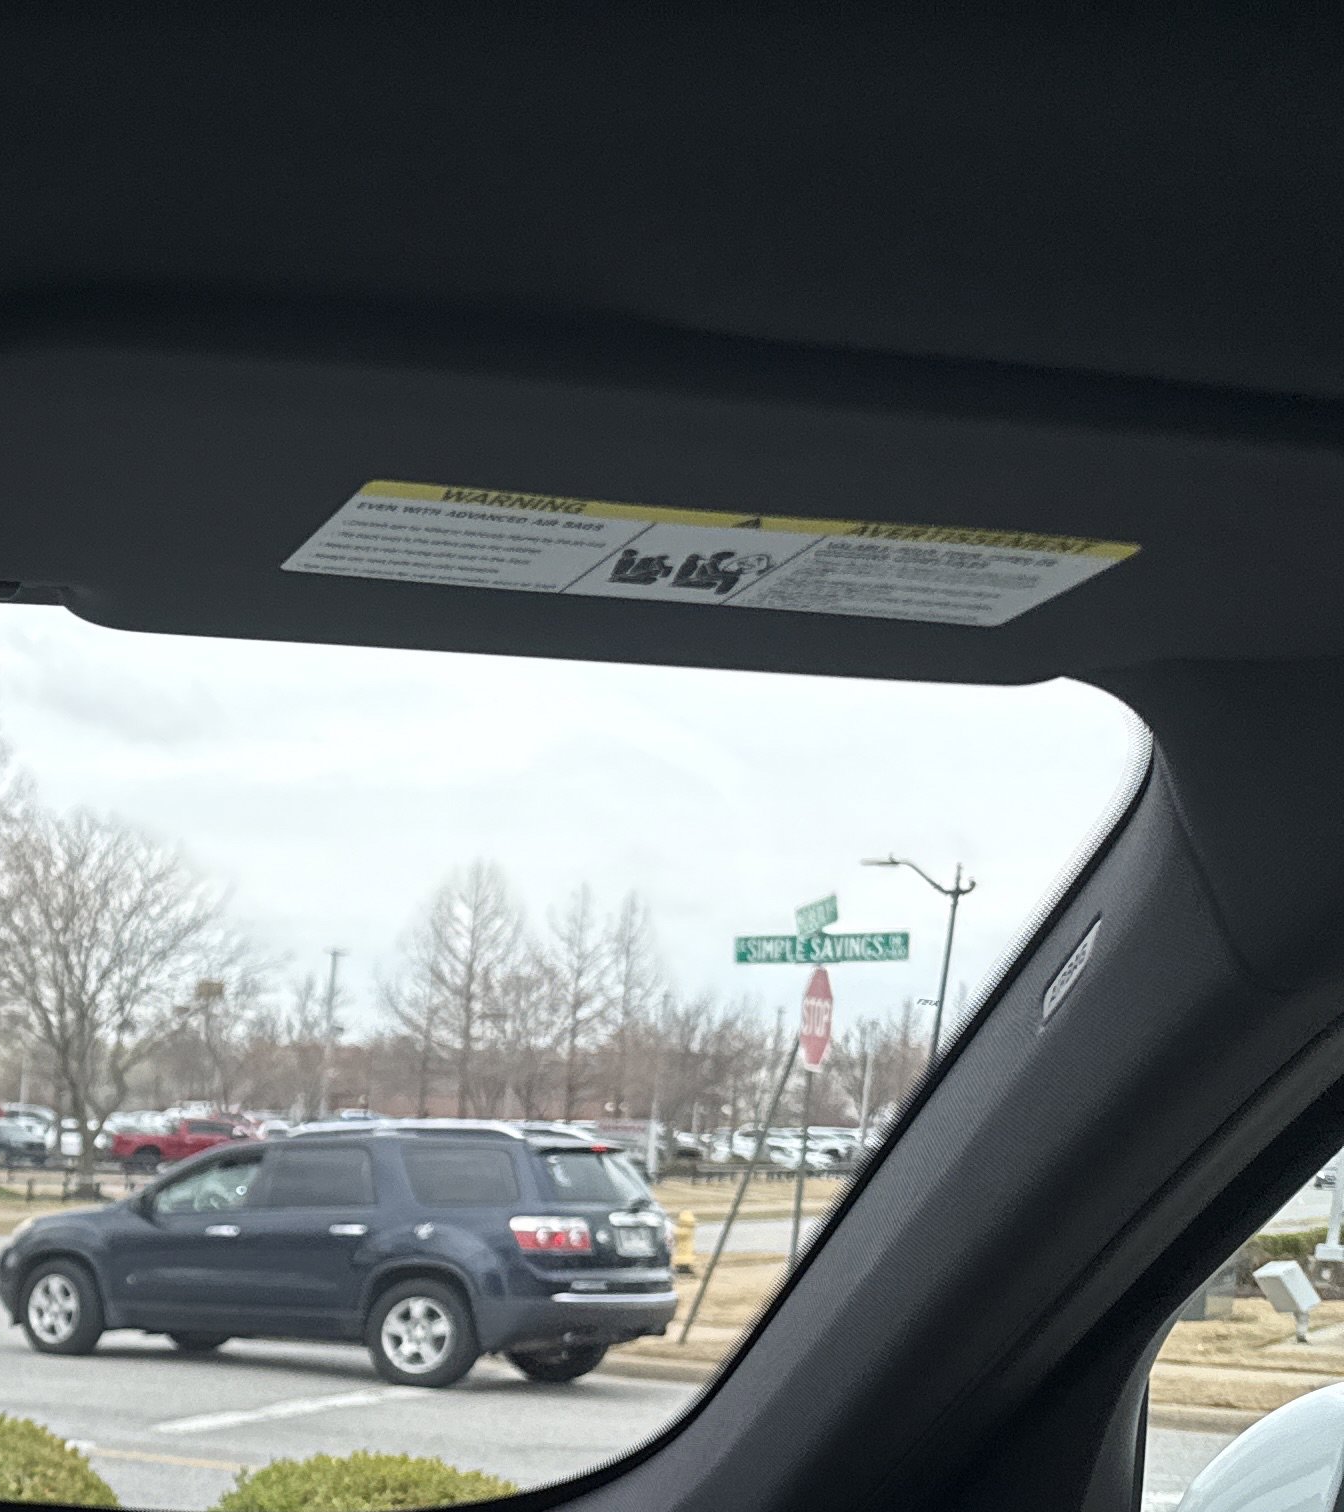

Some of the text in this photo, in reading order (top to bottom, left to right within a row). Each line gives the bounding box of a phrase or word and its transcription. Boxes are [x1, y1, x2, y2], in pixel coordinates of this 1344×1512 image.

[357, 501, 398, 513] EVEN
[402, 506, 442, 517] WITH
[445, 510, 528, 525] ADVANCED
[532, 517, 561, 528] AIR
[441, 489, 587, 515] WARNING
[746, 935, 884, 962] SIMPLE SAVINGS
[803, 999, 832, 1037] STOP
